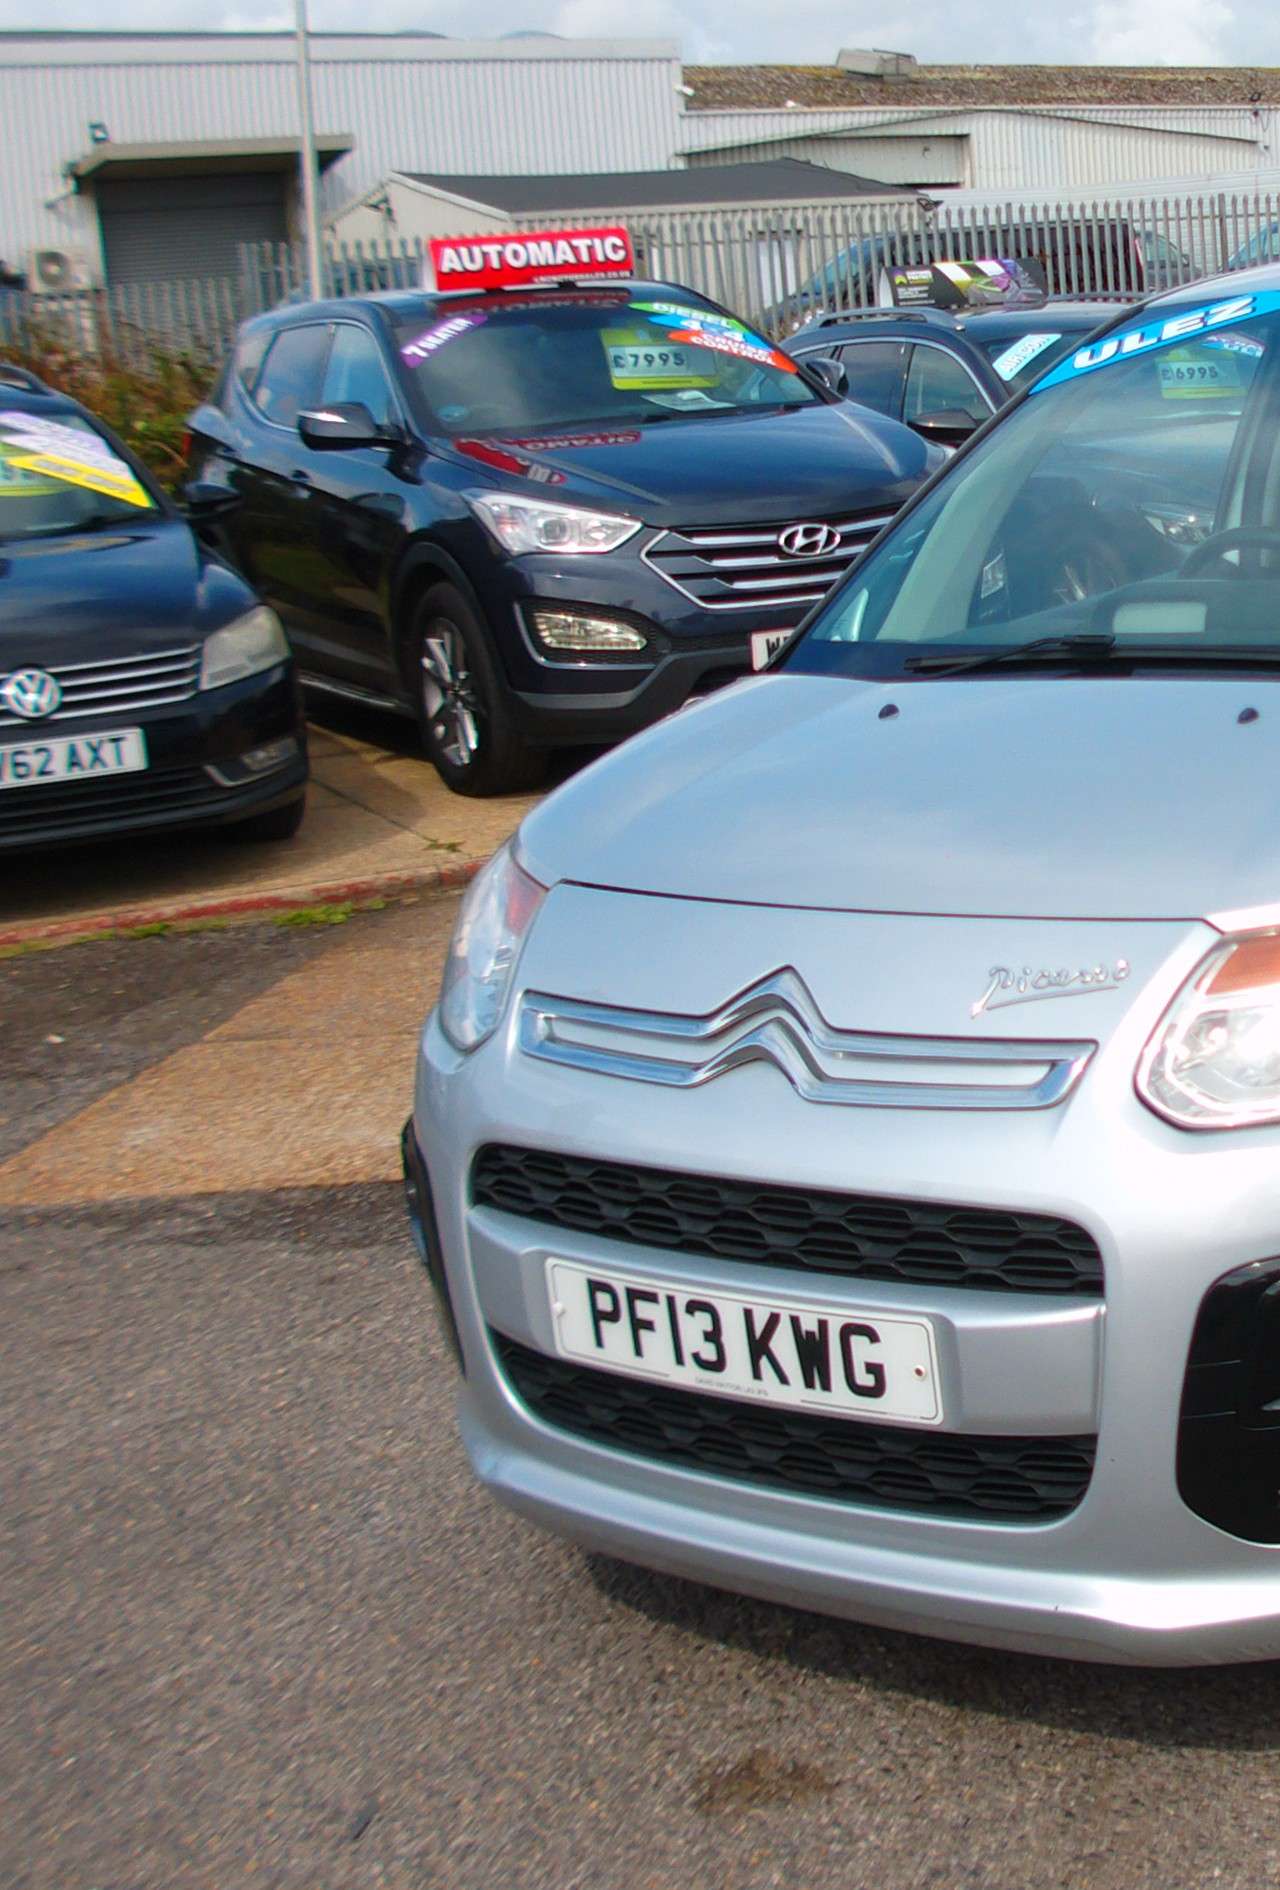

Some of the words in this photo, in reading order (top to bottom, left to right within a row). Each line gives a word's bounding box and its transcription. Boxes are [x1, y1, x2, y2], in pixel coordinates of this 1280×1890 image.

[440, 235, 628, 274] AUTOMATIC
[1073, 296, 1255, 369] ULEZ
[612, 352, 686, 369] £7995
[1160, 364, 1219, 382] £6995
[66, 735, 128, 774] AXT
[586, 1277, 728, 1375] PF13
[742, 1306, 888, 1400] KWG
